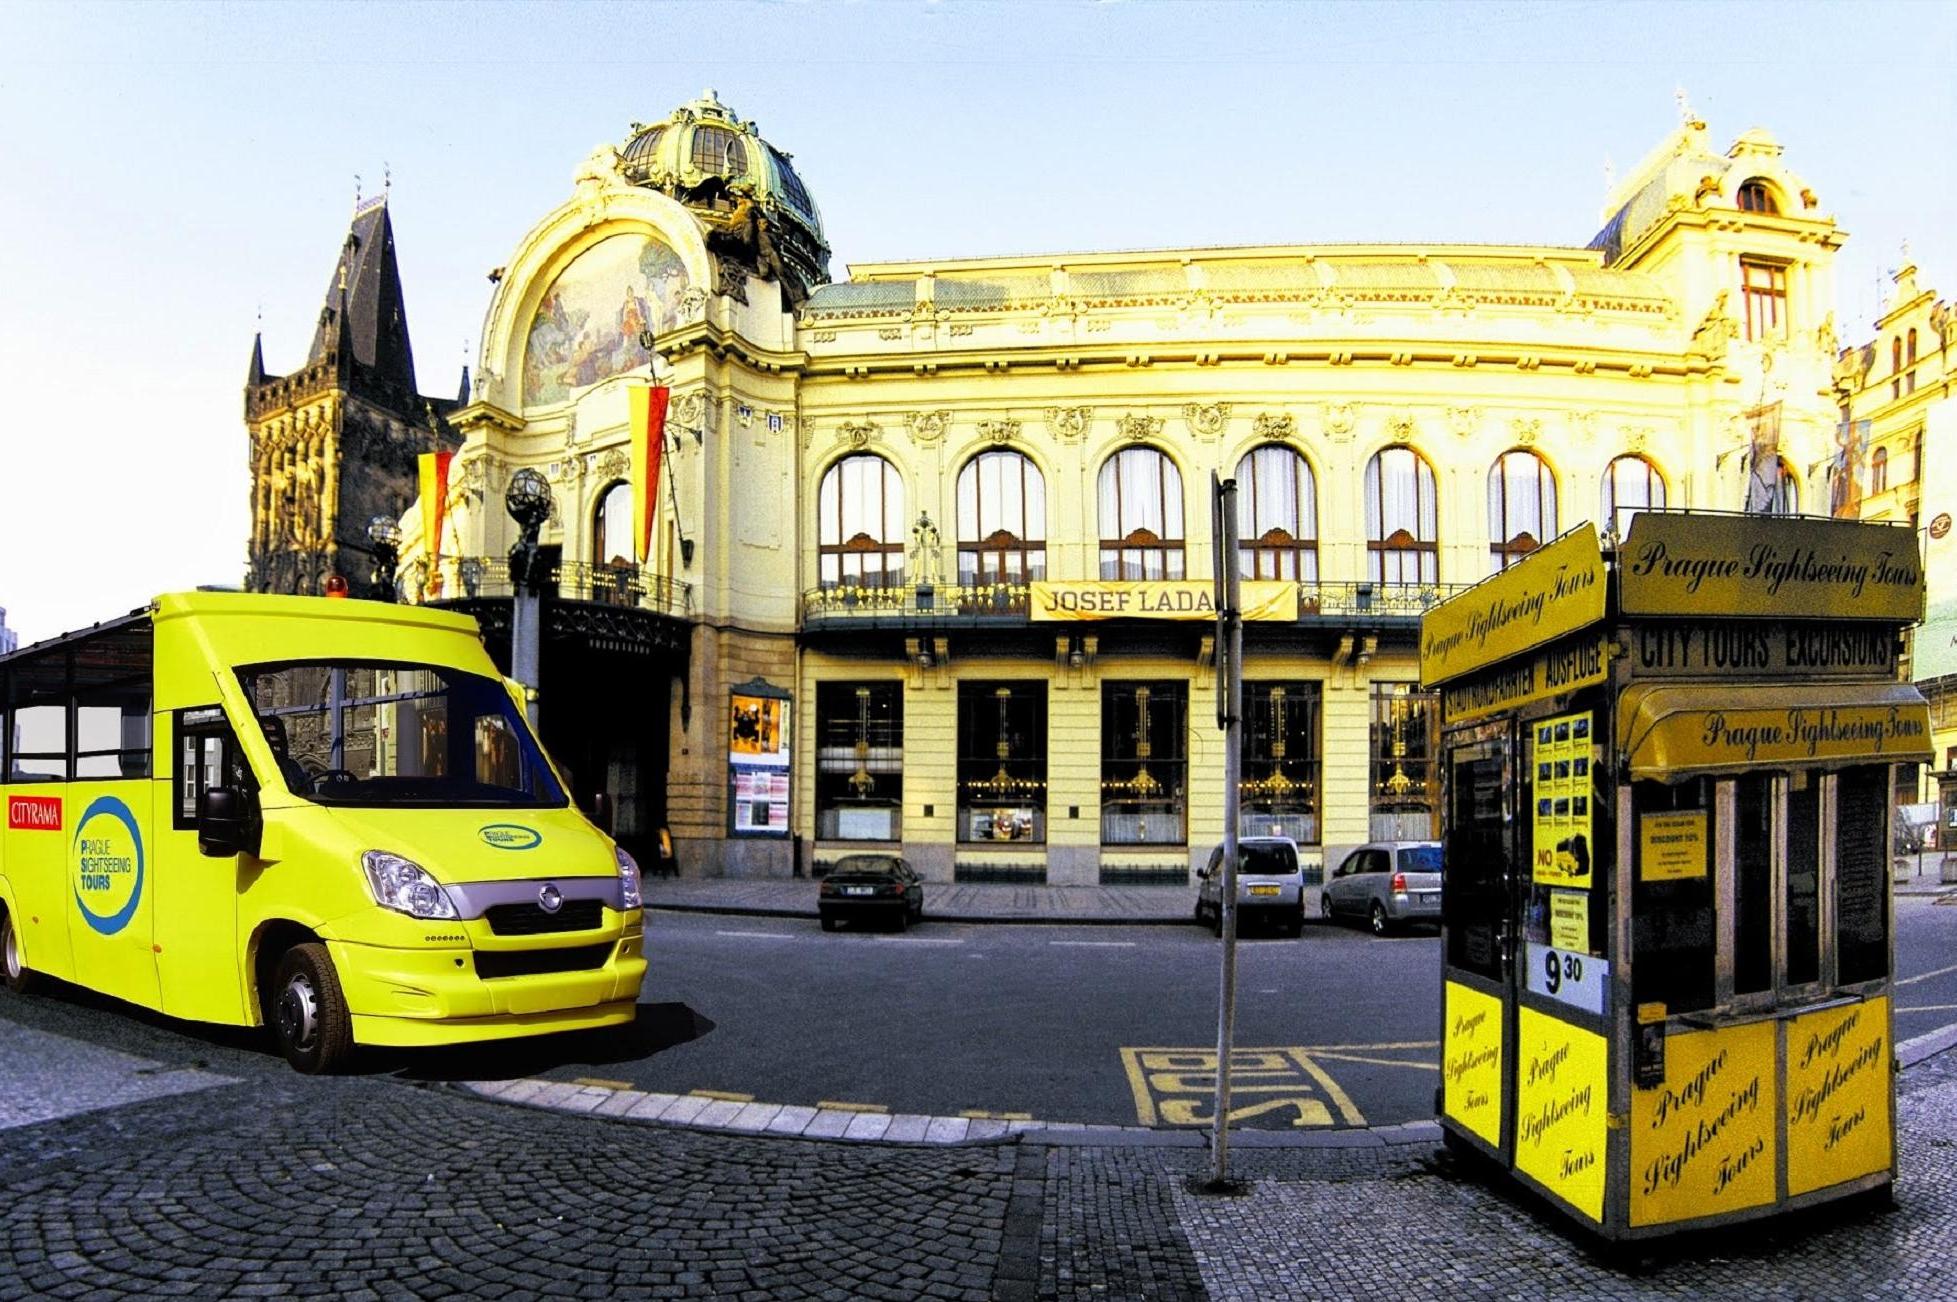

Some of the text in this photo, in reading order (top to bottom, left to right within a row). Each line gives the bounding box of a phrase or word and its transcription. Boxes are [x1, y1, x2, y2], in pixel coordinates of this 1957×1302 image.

[1633, 541, 1918, 598] Prague Sightseeing Tours
[1044, 590, 1216, 612] JOSEF LADA
[1423, 565, 1595, 664] Prague Sightseeing Tours
[1640, 625, 1888, 668] CITY TOURS EXCURSIONS
[1702, 705, 1923, 760] Prague Sightseeing Tours
[11, 802, 59, 825] CITYRAMA
[81, 840, 110, 855] PRAGUE
[81, 858, 131, 873] SIGHTSEEING
[1537, 848, 1553, 866] NO
[81, 875, 110, 890] TOURS
[1545, 951, 1582, 994] 9 30
[1453, 1010, 1486, 1039] Prague
[1801, 1010, 1860, 1069] Prague
[1446, 1045, 1499, 1084] Sightseeing
[1527, 1042, 1570, 1087] Prague
[1790, 1036, 1882, 1125] Sightseeing
[1142, 1053, 1335, 1125] BUS
[1464, 1090, 1489, 1112] Tours
[1652, 1049, 1728, 1129] Prague
[1521, 1084, 1592, 1148] Sightseeing
[1643, 1076, 1760, 1195] Sightseeing
[1824, 1105, 1865, 1151] Tours
[1560, 1150, 1595, 1180] Tours
[1713, 1137, 1764, 1195] Tours
